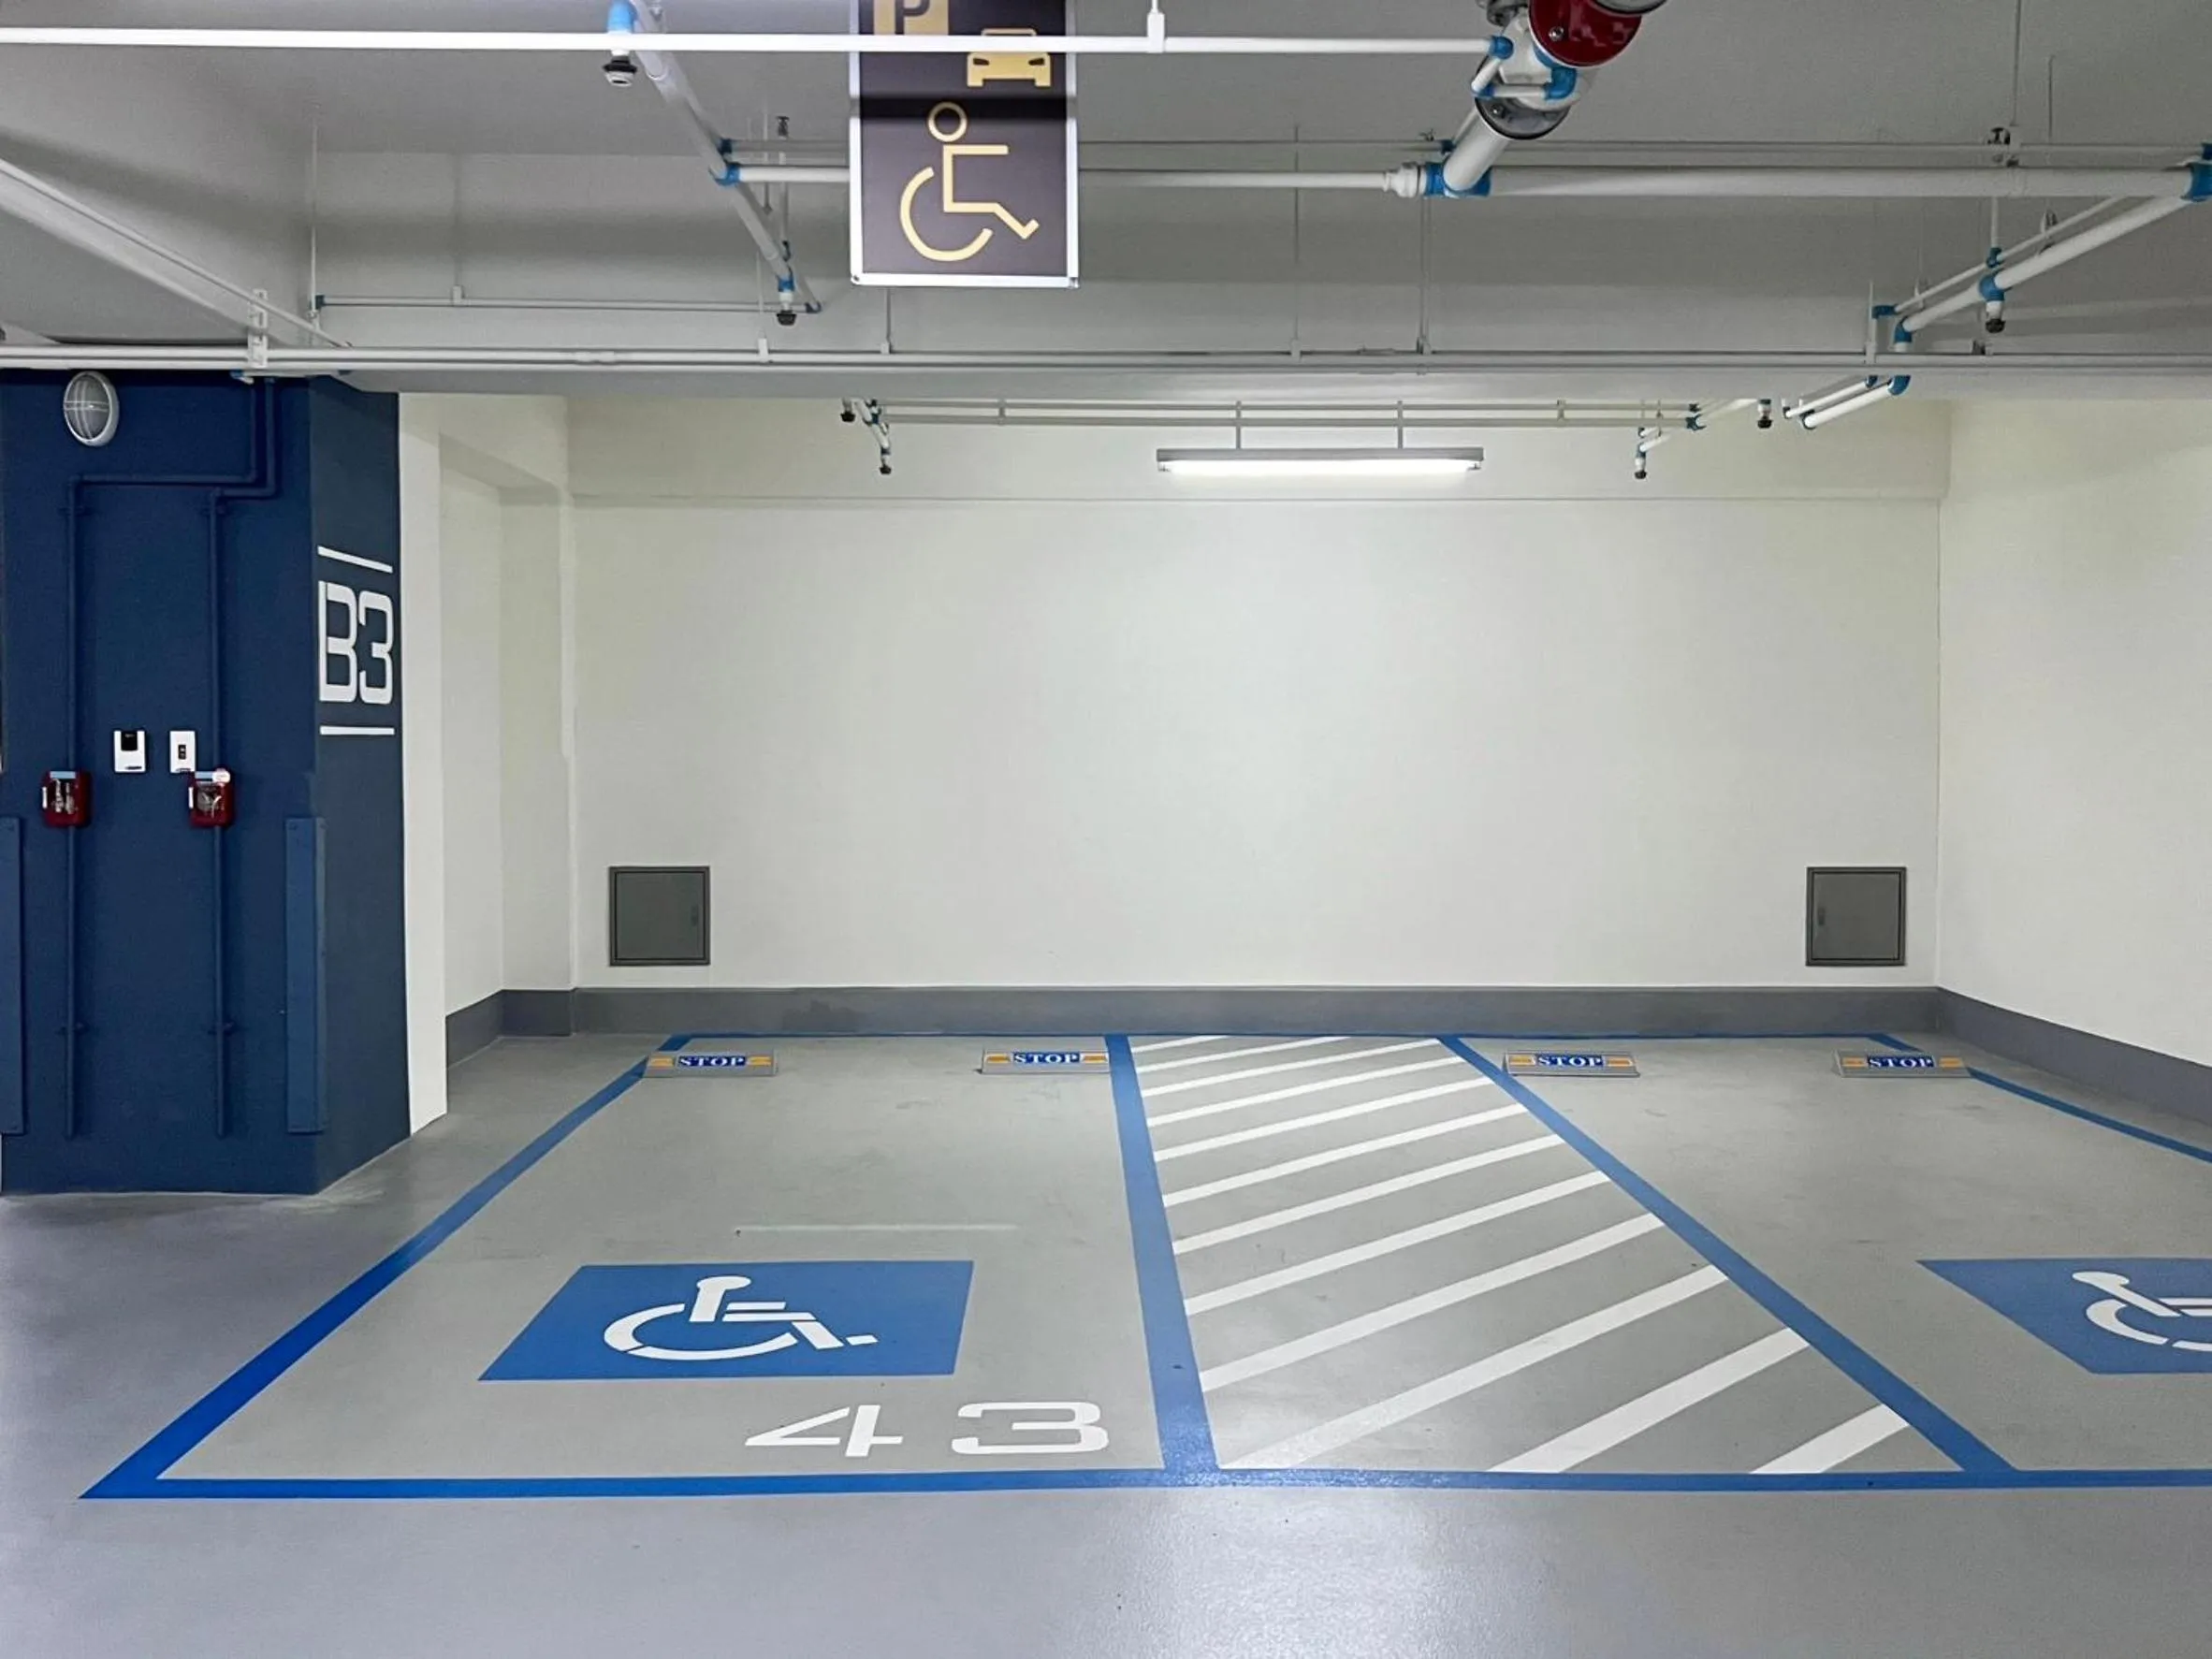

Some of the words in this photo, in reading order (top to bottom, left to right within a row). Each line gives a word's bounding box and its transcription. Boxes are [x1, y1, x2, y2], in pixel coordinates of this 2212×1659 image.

[318, 580, 394, 705] B3
[679, 1055, 746, 1067] STOP
[1013, 1052, 1080, 1064] STOP
[1536, 1054, 1603, 1067] STOP
[1869, 1055, 1934, 1068] STOP
